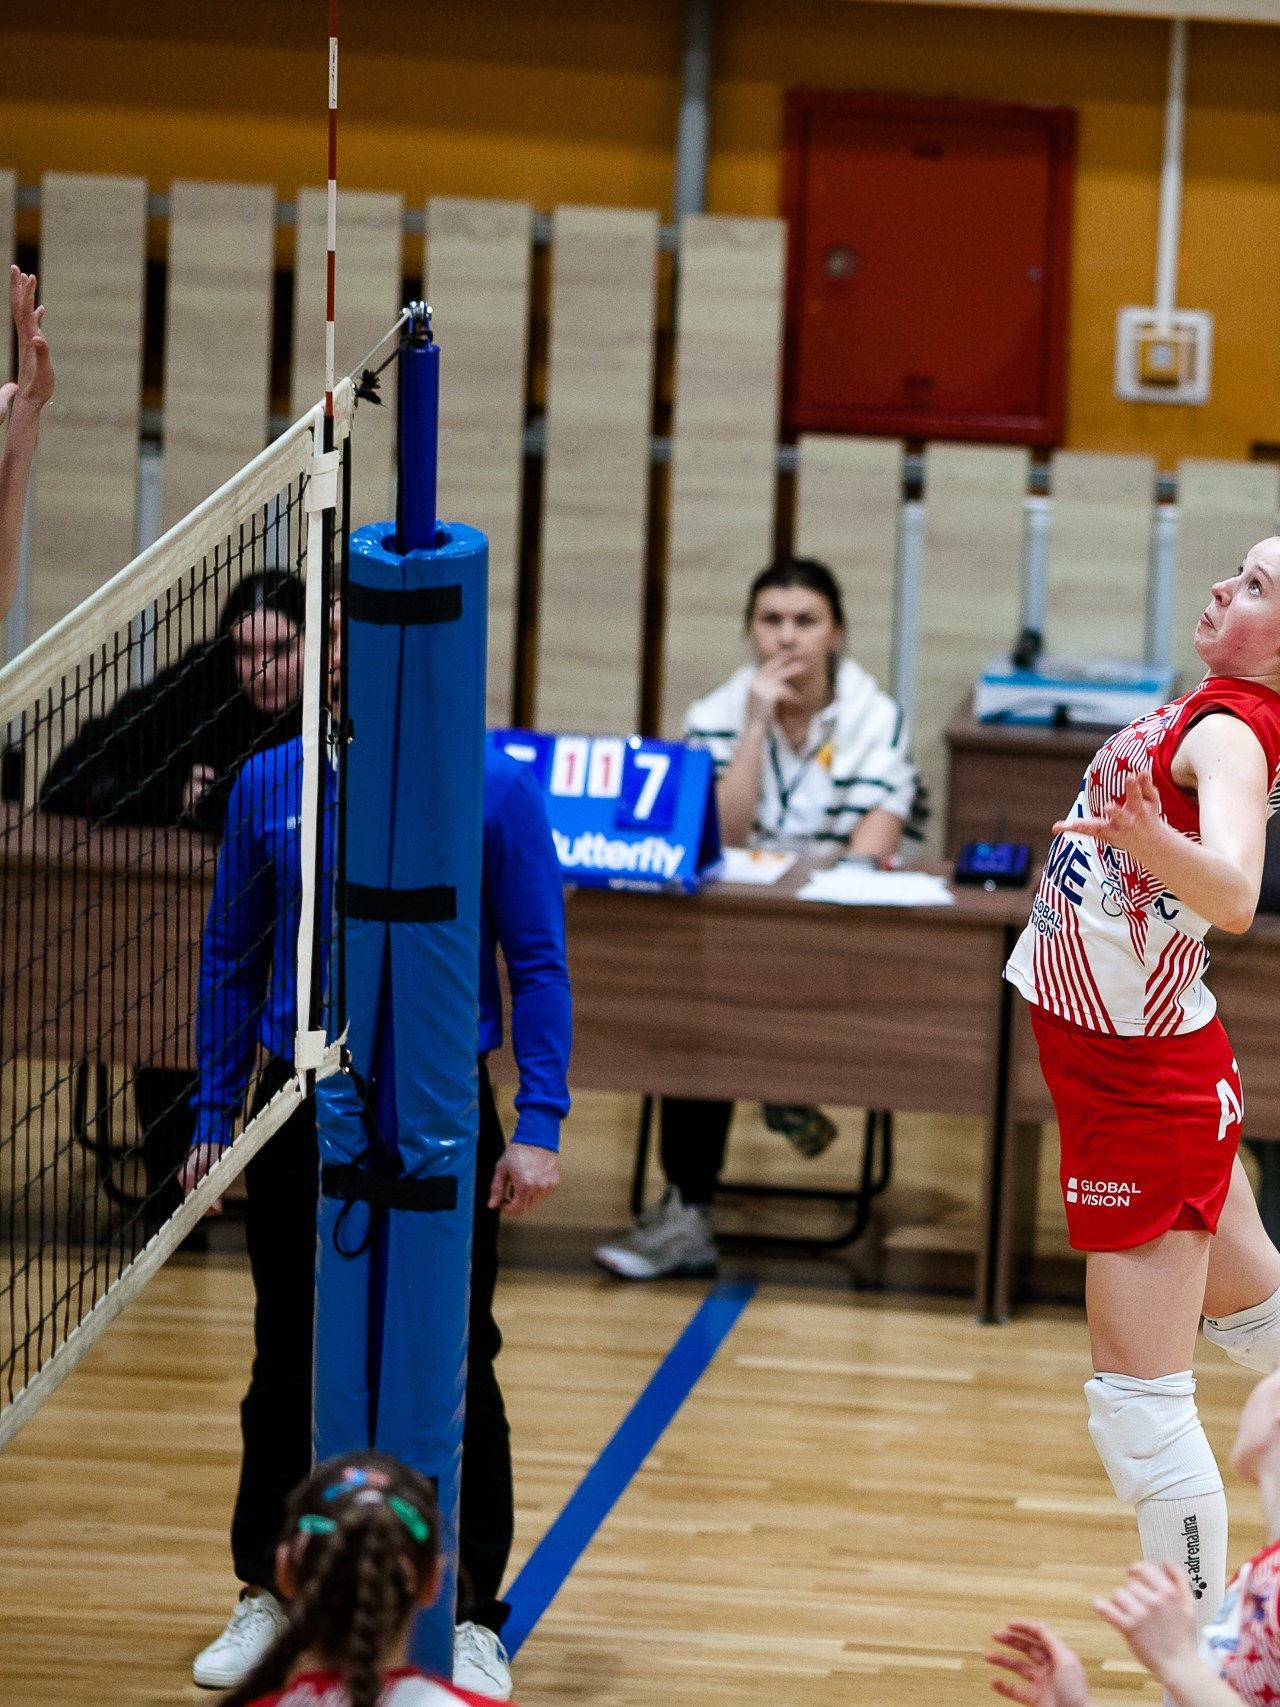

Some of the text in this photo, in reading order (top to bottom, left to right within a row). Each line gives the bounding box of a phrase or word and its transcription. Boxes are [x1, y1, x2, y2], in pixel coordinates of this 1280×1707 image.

[633, 752, 671, 821] 7
[552, 827, 687, 878] utterfly
[1081, 1180, 1141, 1194] GLOBAL
[1081, 1194, 1131, 1207] VISION
